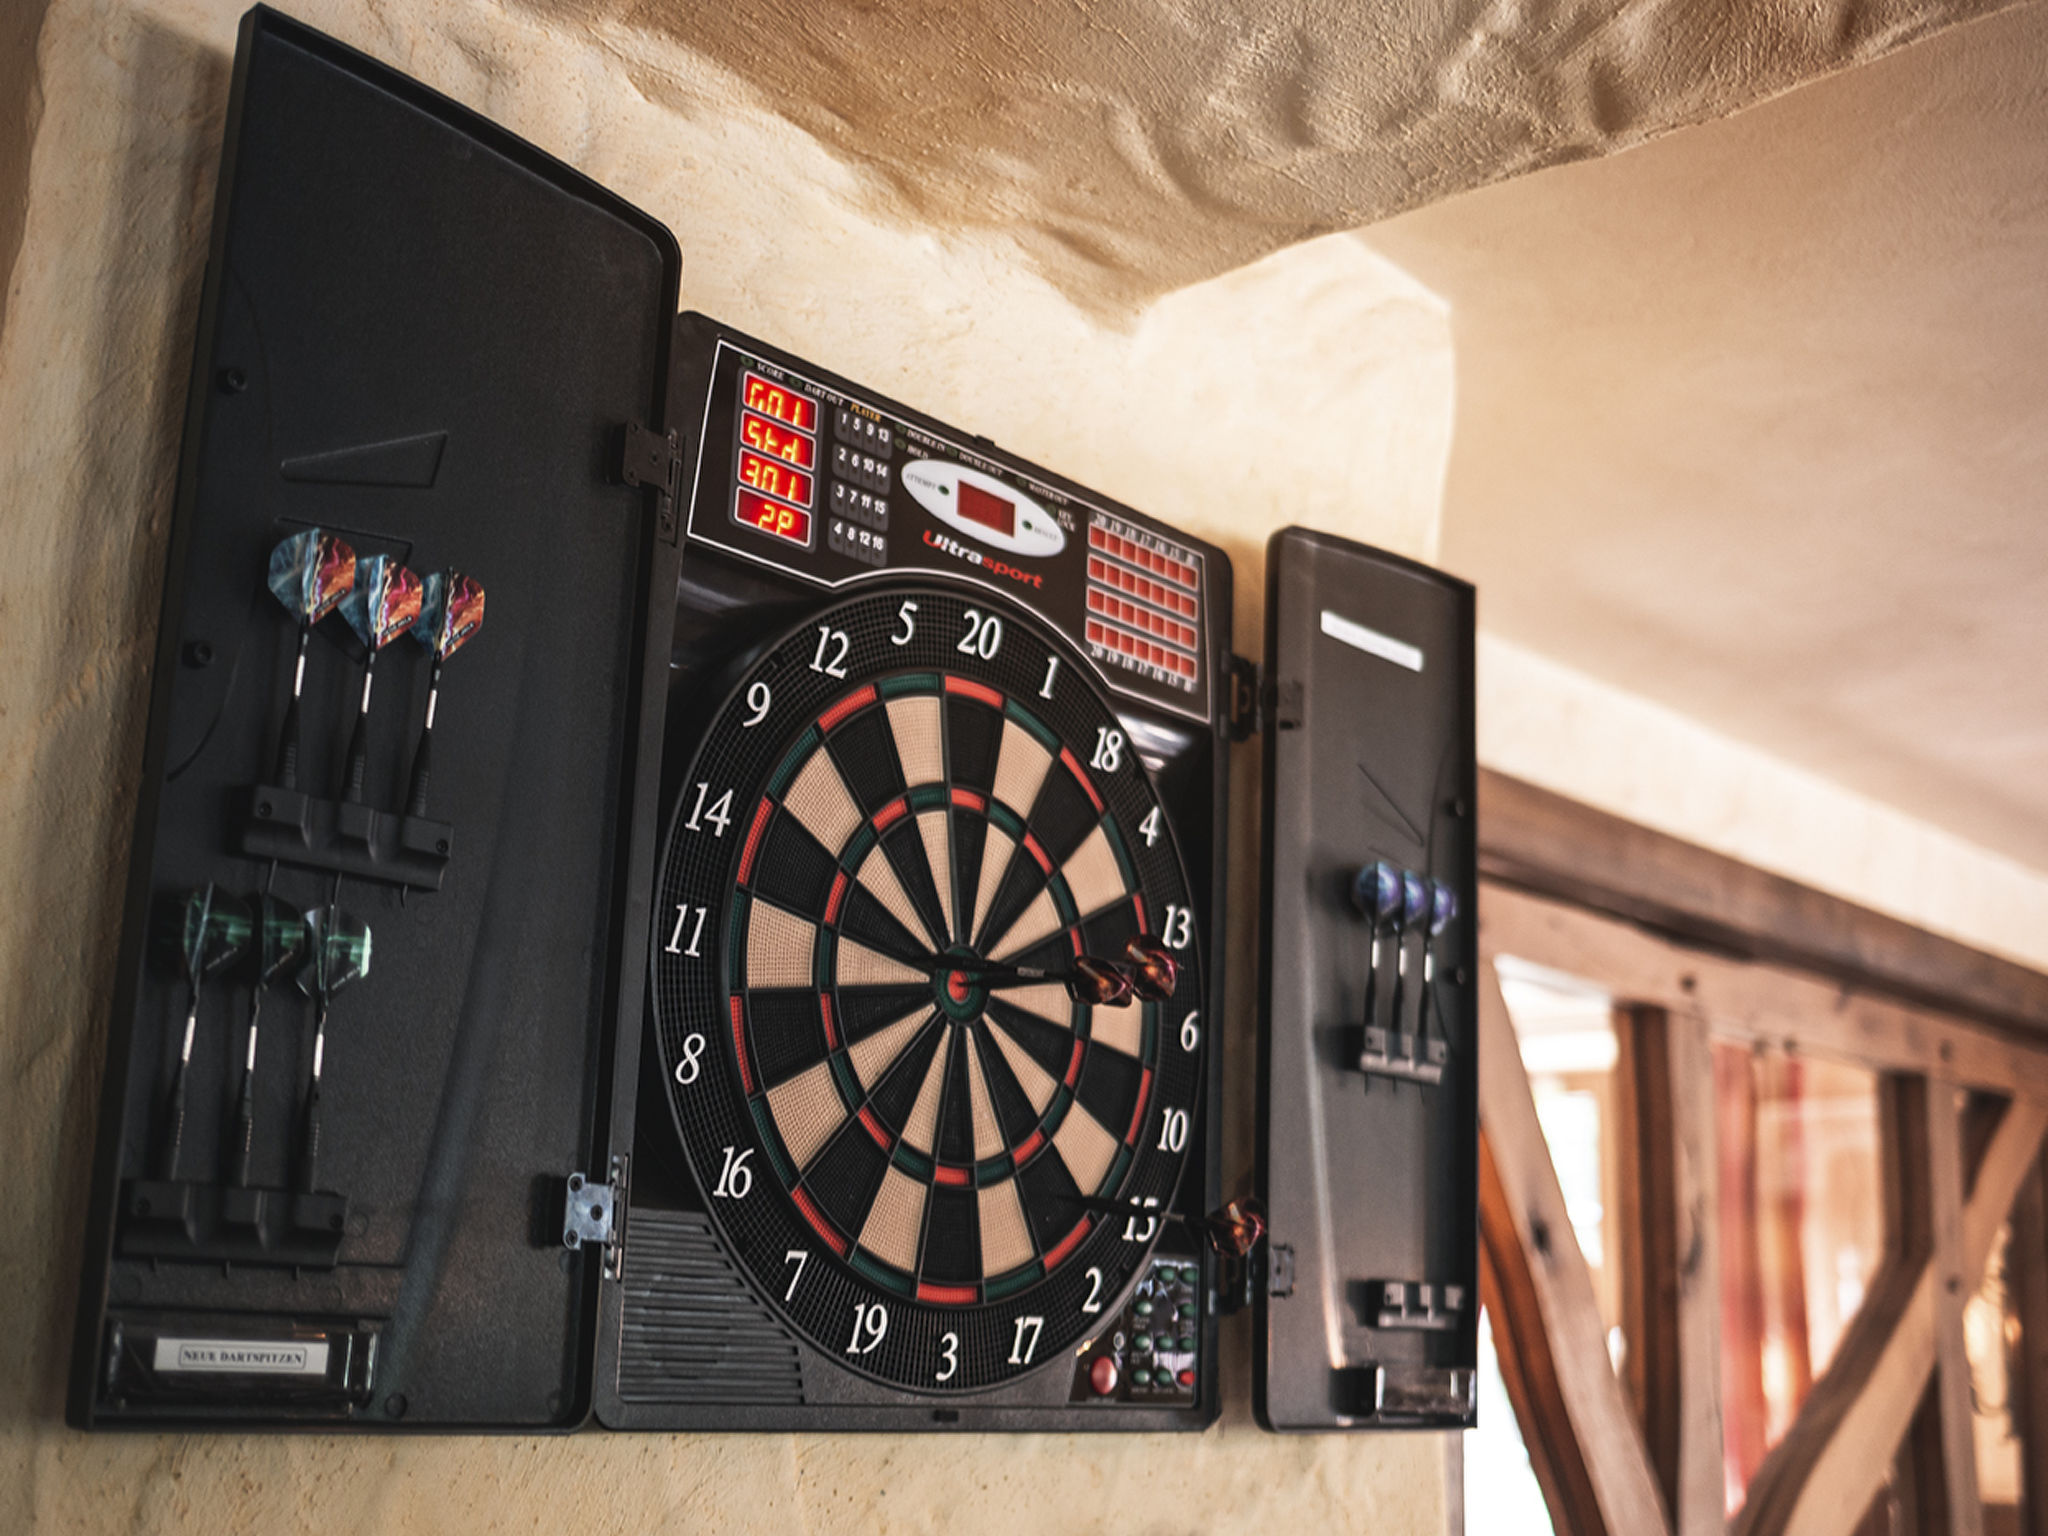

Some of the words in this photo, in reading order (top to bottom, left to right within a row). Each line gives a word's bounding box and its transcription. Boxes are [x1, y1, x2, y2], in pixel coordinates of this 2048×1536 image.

[842, 413, 848, 425] 1
[852, 418, 860, 430] 5
[866, 423, 874, 436] 9
[877, 427, 890, 442] 13
[838, 448, 847, 461] 2
[851, 454, 860, 467] 6
[863, 458, 874, 473] 10
[876, 463, 888, 478] 14
[836, 485, 844, 498] 3
[849, 490, 858, 503] 7
[861, 495, 872, 508] 11
[874, 500, 886, 515] 15
[834, 521, 842, 534] 4
[859, 532, 870, 546] 12
[872, 536, 884, 550] 16
[891, 600, 918, 646] 5
[957, 610, 1002, 660] 20
[809, 626, 849, 679] 12
[1039, 656, 1059, 700] 1
[742, 681, 771, 727] 9
[1089, 727, 1122, 773] 18
[685, 782, 734, 837] 14
[1138, 806, 1160, 847] 4
[665, 904, 707, 957] 11
[1162, 904, 1191, 950] 13
[1180, 1010, 1199, 1052] 6
[675, 1033, 706, 1085] 8
[1157, 1107, 1189, 1153] 10
[713, 1146, 754, 1199] 16
[784, 1250, 808, 1302] 7
[1082, 1266, 1102, 1313] 2
[846, 1303, 888, 1354] 19
[1007, 1316, 1044, 1365] 17
[183, 1349, 216, 1362] NEUE
[219, 1350, 302, 1365] DARTSPITZEN
[935, 1332, 959, 1381] 3
